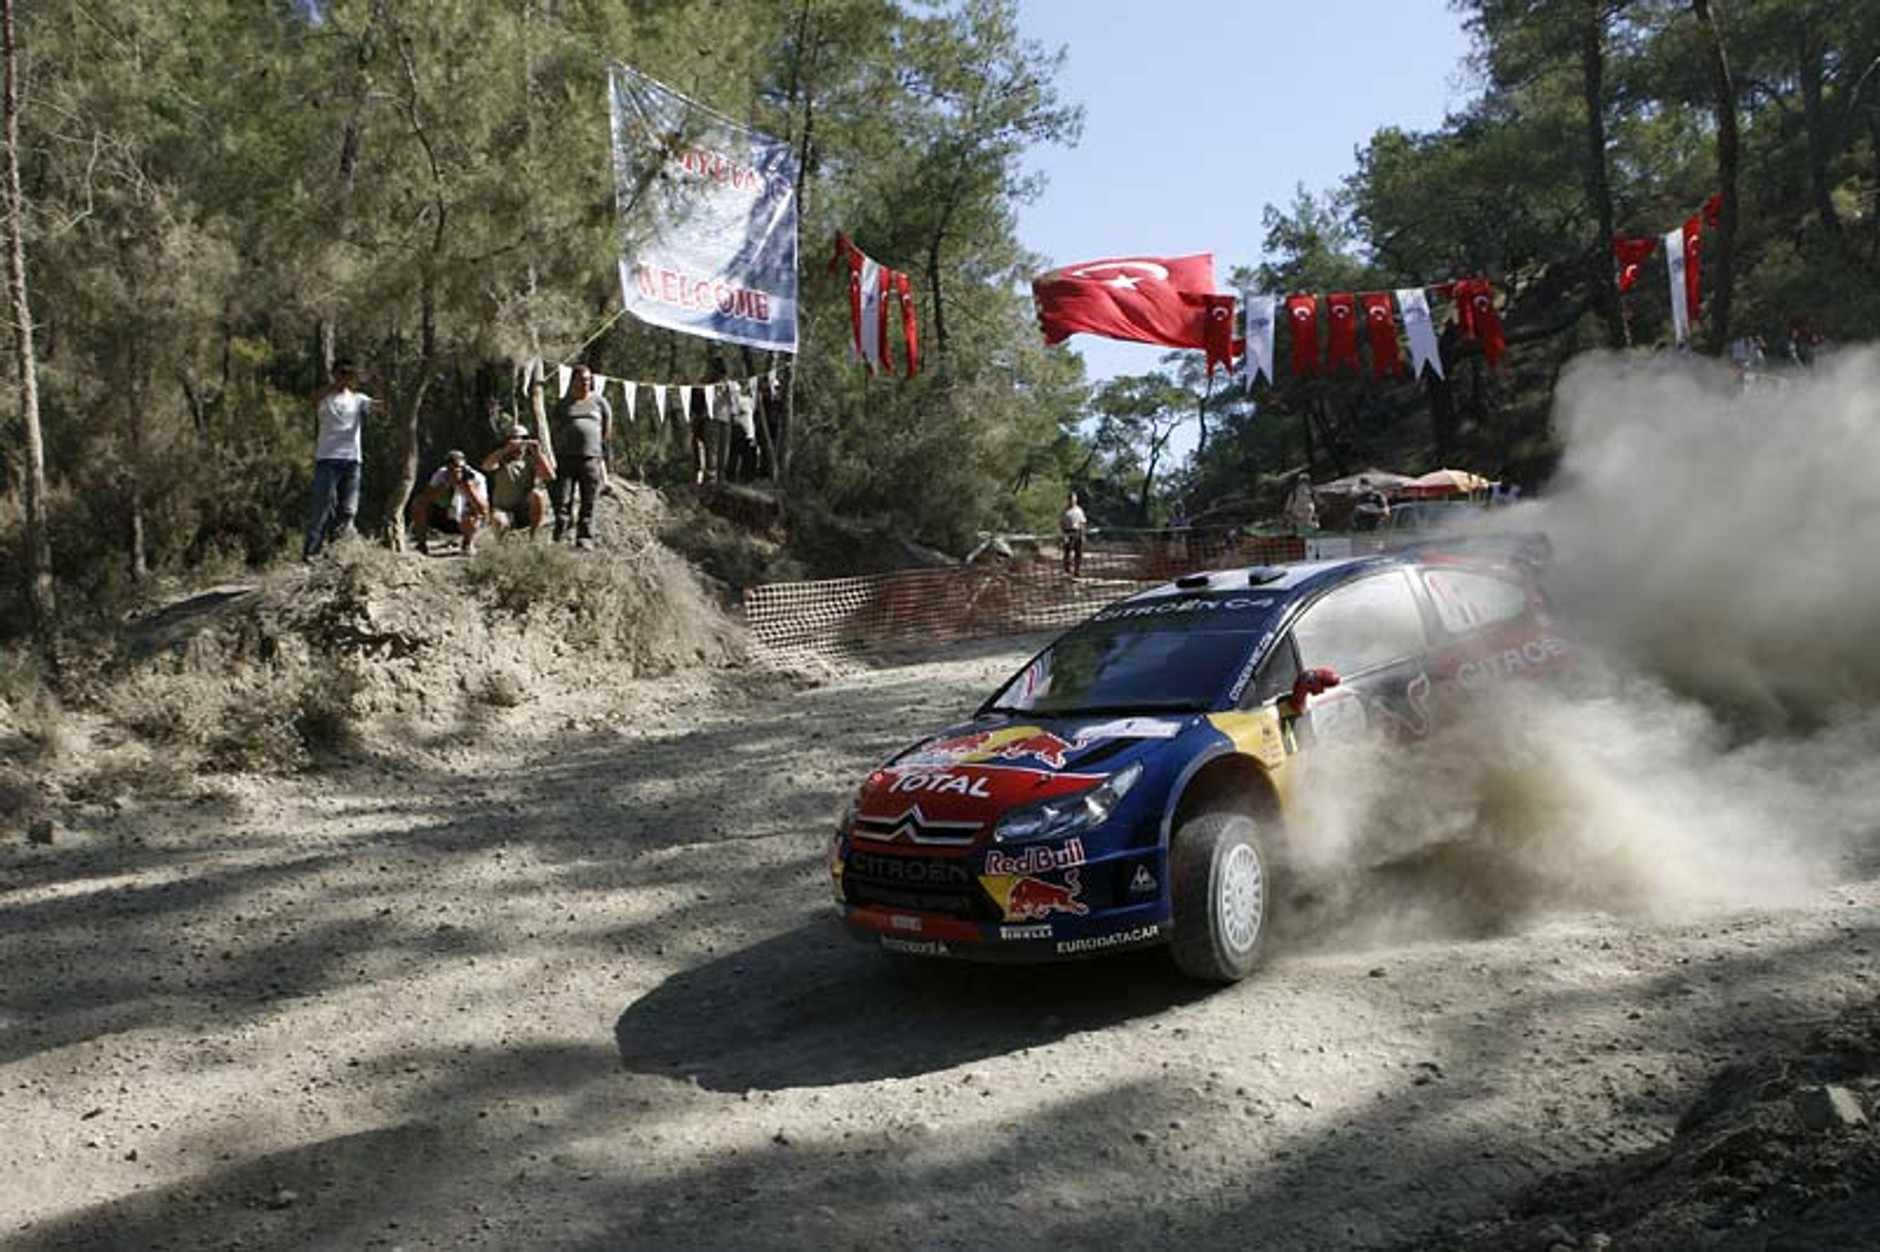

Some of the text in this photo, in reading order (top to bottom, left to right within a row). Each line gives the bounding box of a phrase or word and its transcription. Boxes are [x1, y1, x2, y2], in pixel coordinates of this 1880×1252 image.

[638, 262, 769, 322] WELCOME
[887, 769, 990, 798] TOTAL
[1057, 924, 1160, 953] EURODATACAR
